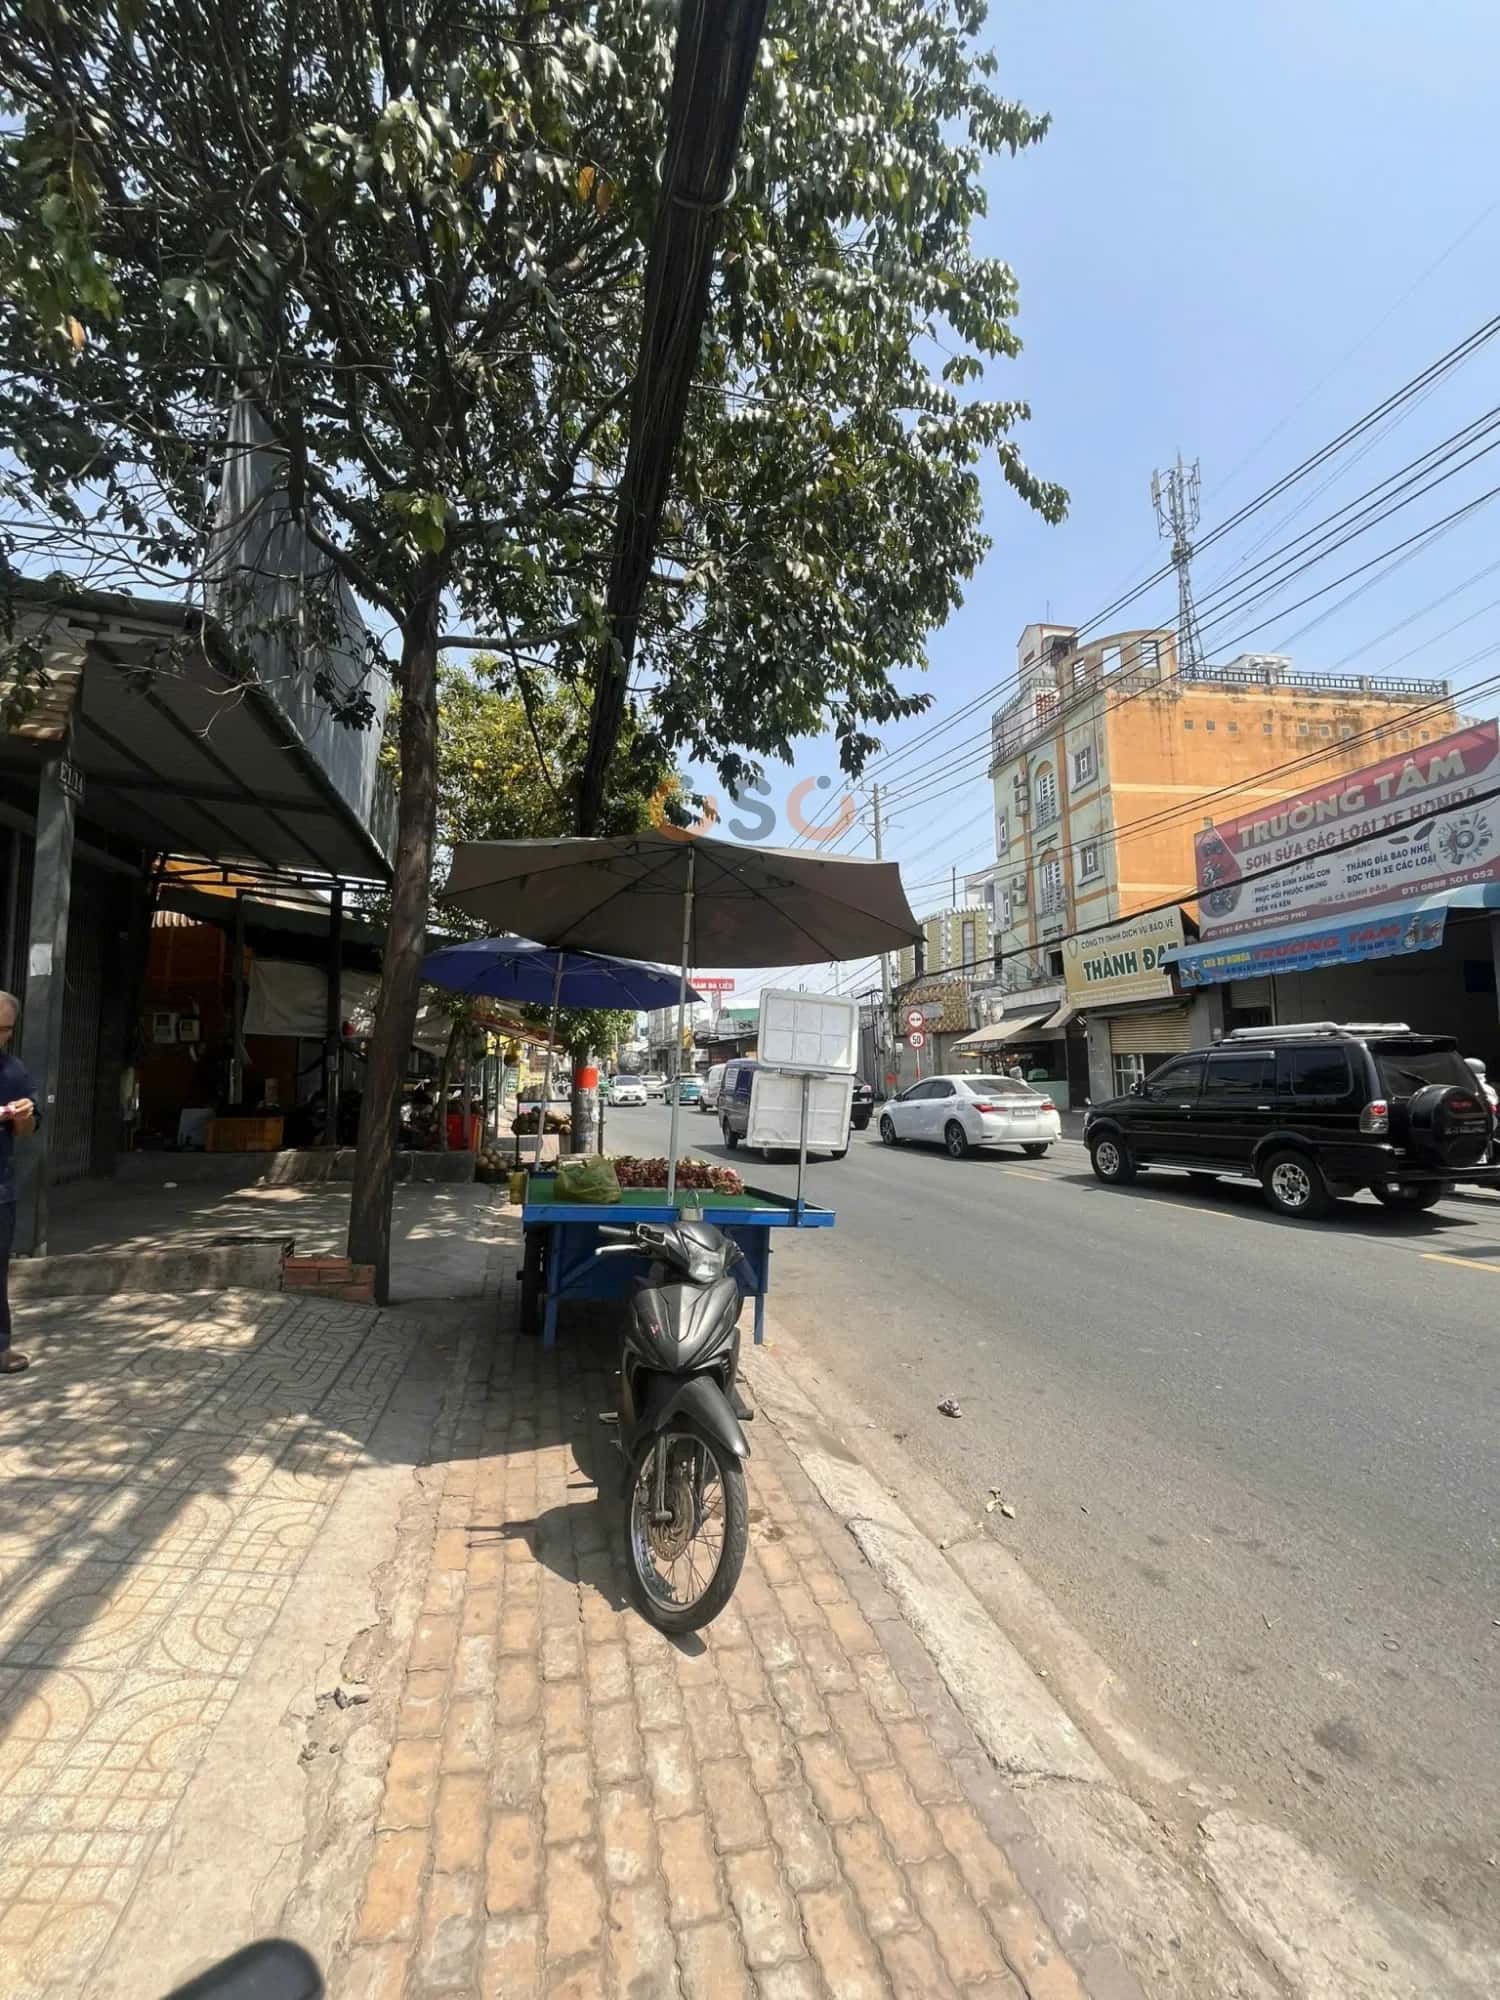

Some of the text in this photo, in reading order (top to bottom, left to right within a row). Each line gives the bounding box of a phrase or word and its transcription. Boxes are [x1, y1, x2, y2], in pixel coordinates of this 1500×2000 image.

[1238, 748, 1466, 849] TRƯỜNG TÂM
[1246, 849, 1271, 872] SƠN
[1381, 809, 1403, 830] XE
[1409, 787, 1477, 820] HONDA
[1083, 949, 1138, 981] THÀNH
[912, 1034, 921, 1045] 50
